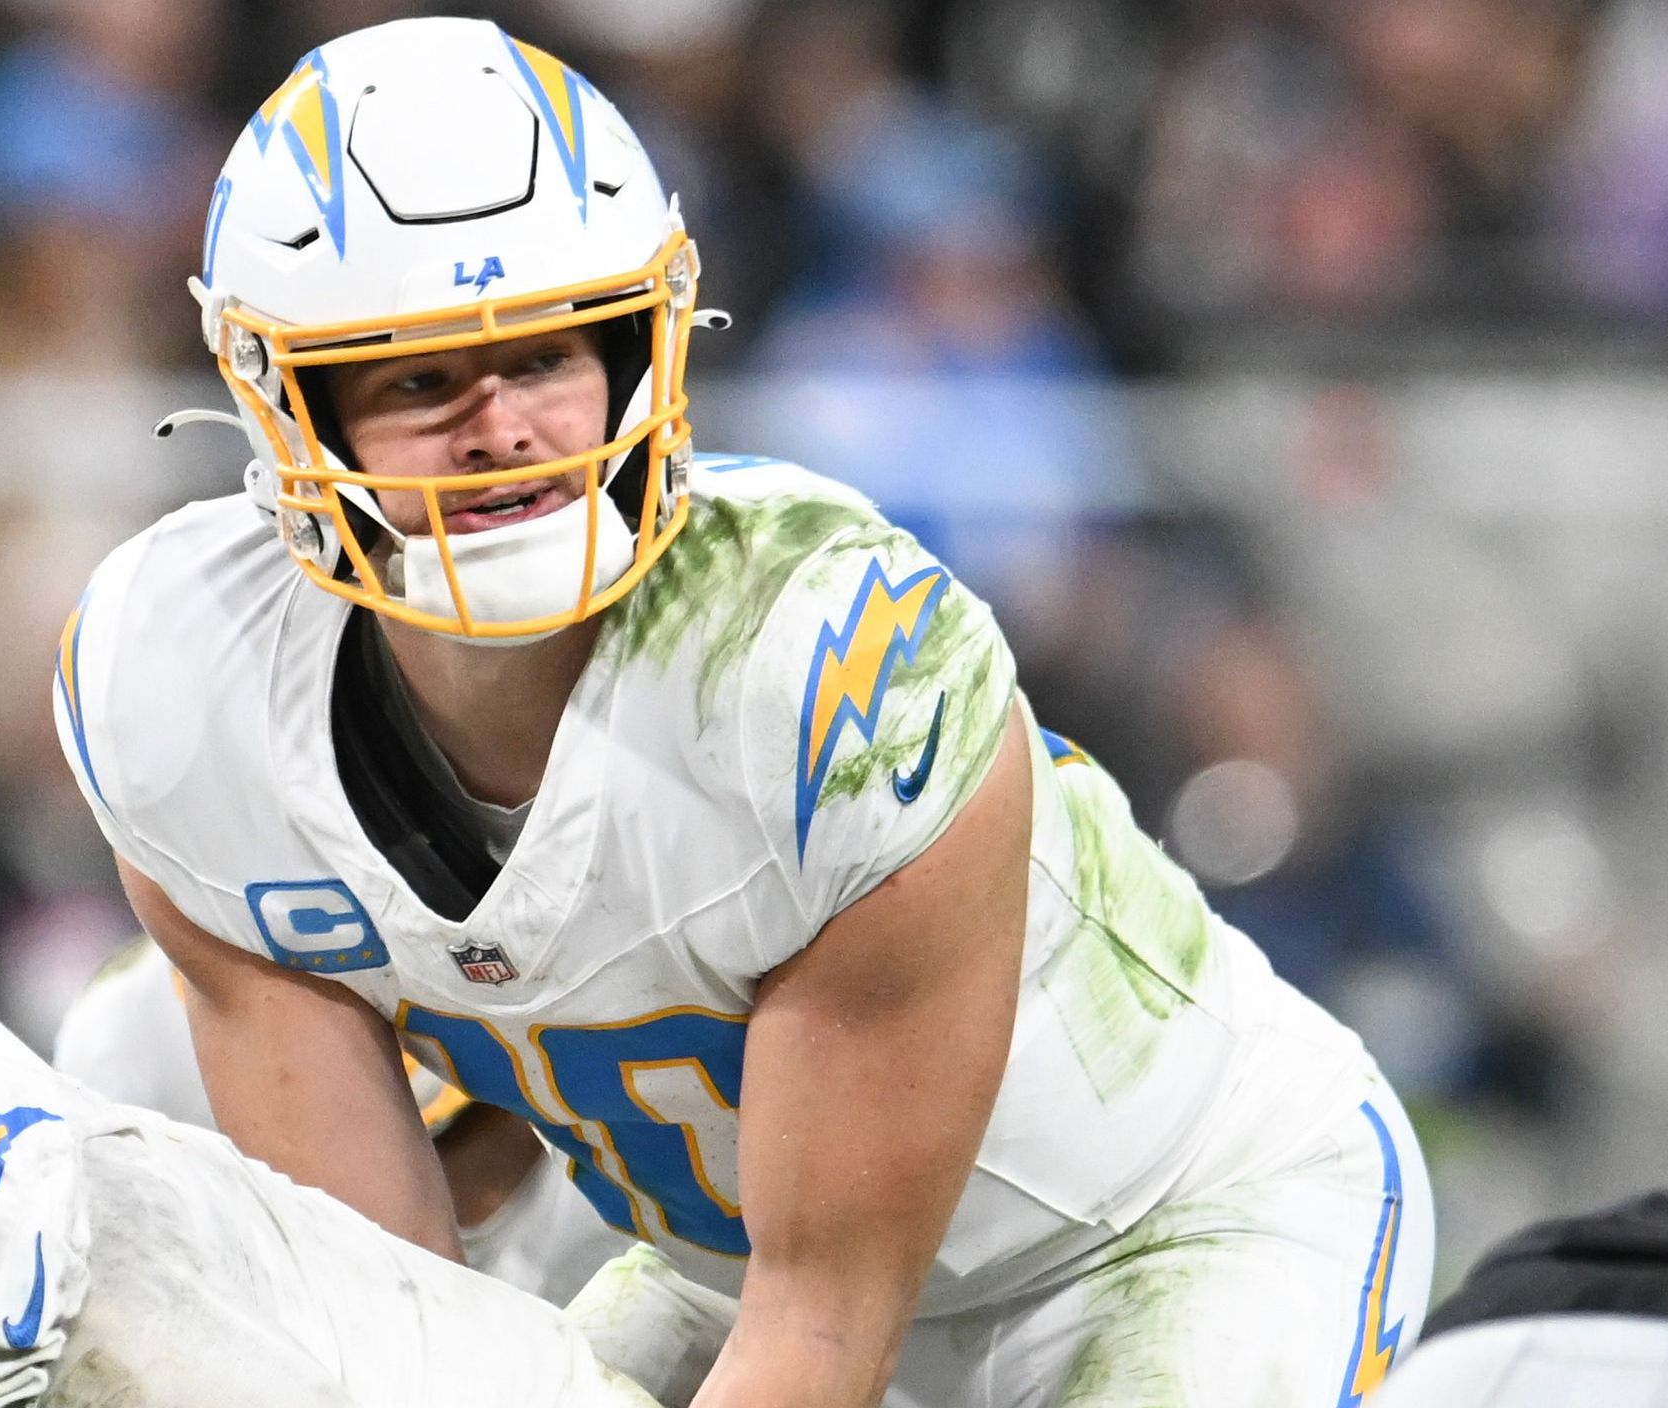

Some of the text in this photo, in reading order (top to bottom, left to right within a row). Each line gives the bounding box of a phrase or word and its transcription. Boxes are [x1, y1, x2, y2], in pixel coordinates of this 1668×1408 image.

[454, 256, 505, 296] LA
[259, 888, 365, 953] C
[466, 962, 511, 982] NFL
